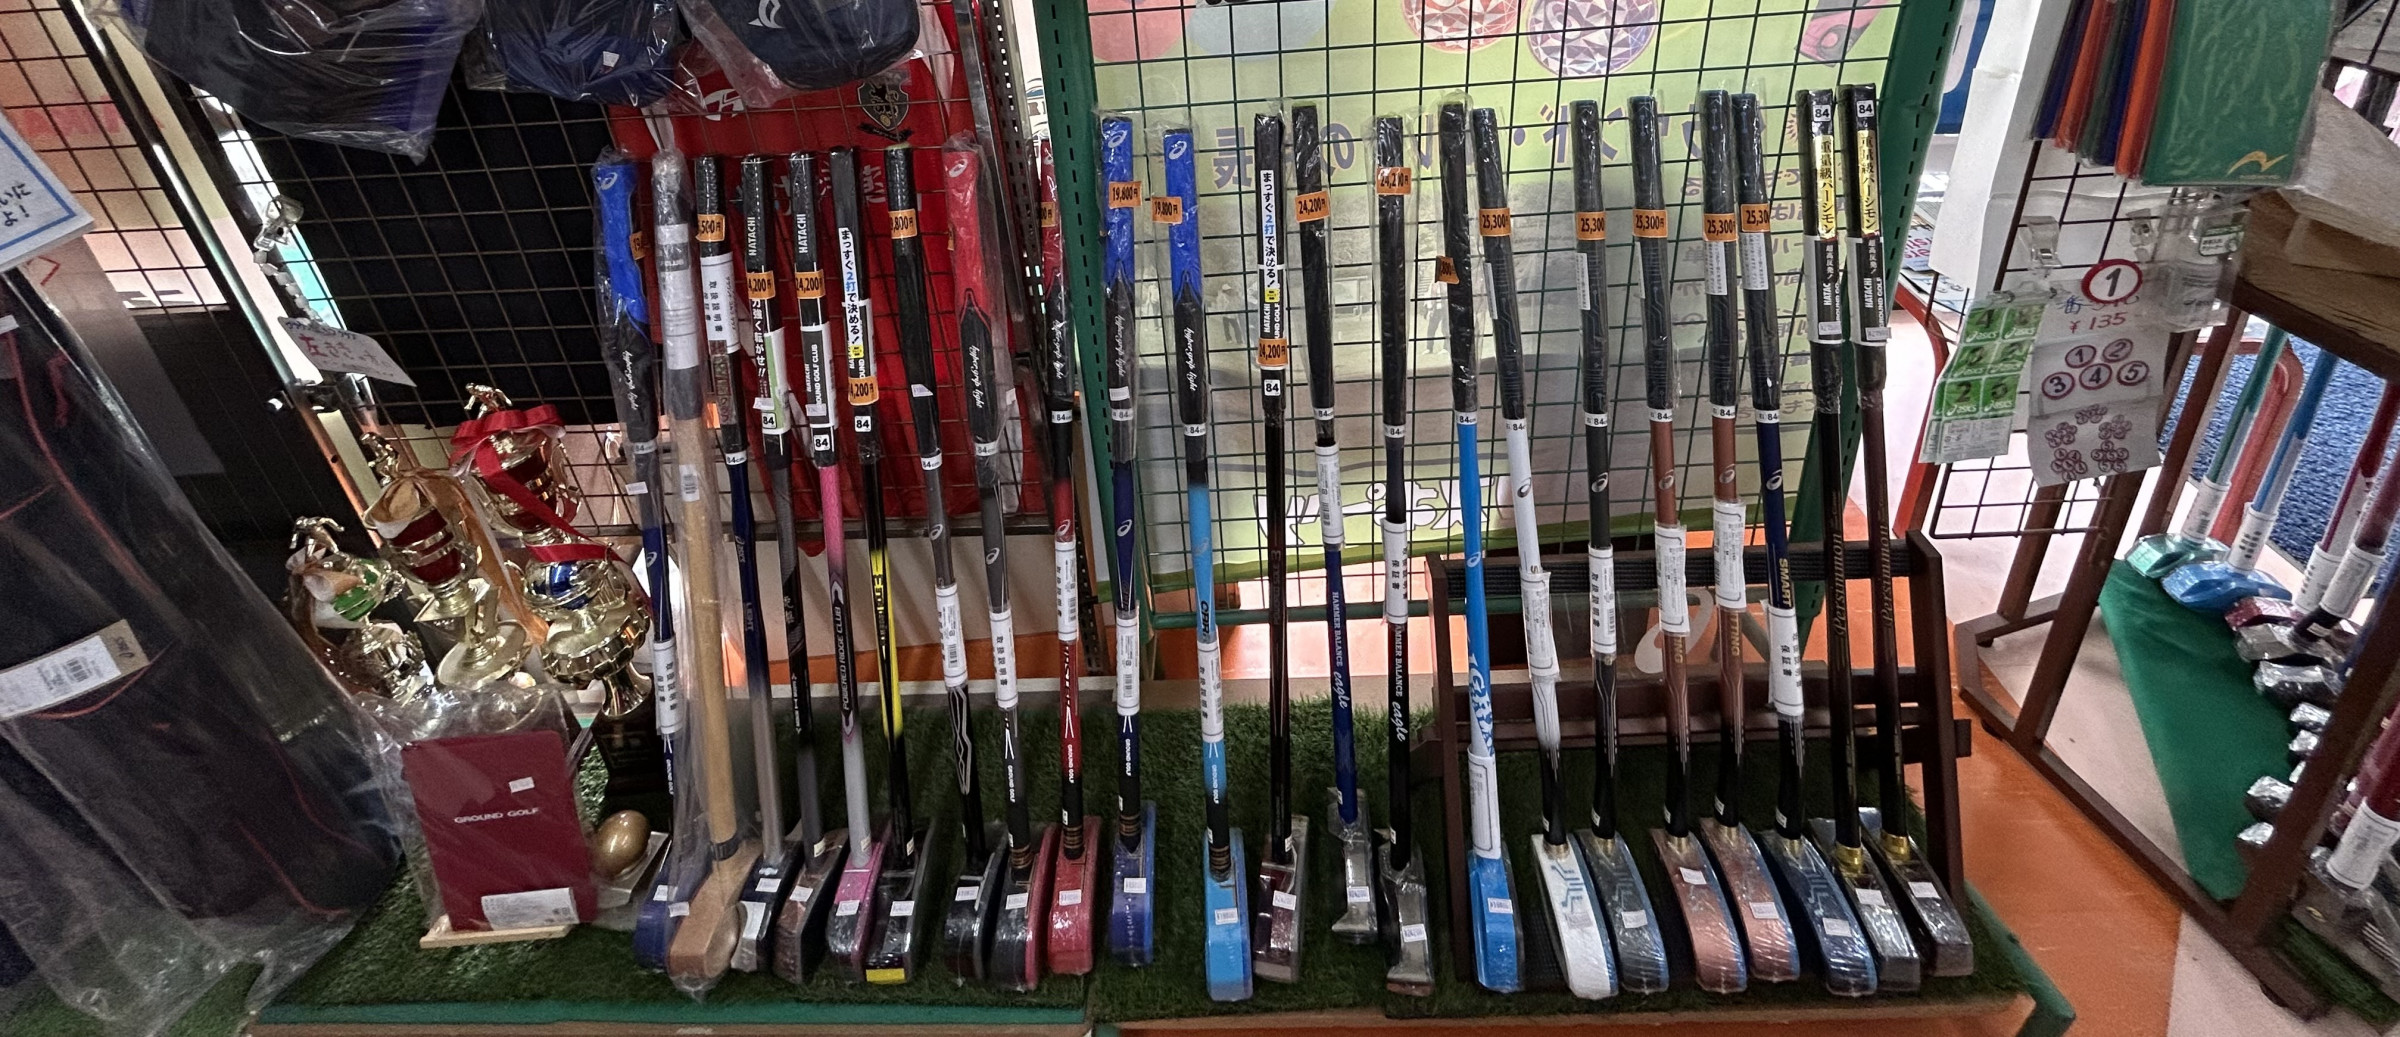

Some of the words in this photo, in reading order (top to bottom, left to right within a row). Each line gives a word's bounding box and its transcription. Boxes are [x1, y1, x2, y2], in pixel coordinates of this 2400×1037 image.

[1815, 108, 1830, 118] 84
[1859, 104, 1873, 114] 84
[1297, 197, 1326, 215] 24,200円
[747, 216, 757, 257] HATACHI
[797, 213, 808, 255] HATACHI
[841, 229, 861, 344] まっすぐ2打で決める！
[1864, 277, 1873, 309] HATACHI
[1263, 303, 1271, 334] HATACHI
[804, 363, 812, 392] HATACHI
[1265, 383, 1279, 392] 84
[763, 416, 775, 425] 84
[856, 419, 870, 428] 84
[815, 438, 828, 448] 84
[1779, 557, 1793, 607] SMART
[1832, 532, 1848, 636] Persimmon
[1880, 524, 1893, 627] Persimmon
[834, 605, 843, 635] CLUB
[1332, 591, 1341, 628] HAMMER
[837, 635, 847, 668] RIDGE
[1334, 629, 1344, 667] BALANCE
[1395, 624, 1404, 657] AMMER
[839, 668, 850, 711] POWERED
[1334, 670, 1349, 709] eagle
[1394, 658, 1403, 698] BALANCE
[1392, 701, 1406, 742] eagle
[453, 811, 504, 825] GROUND
[507, 806, 541, 819] GOLF
